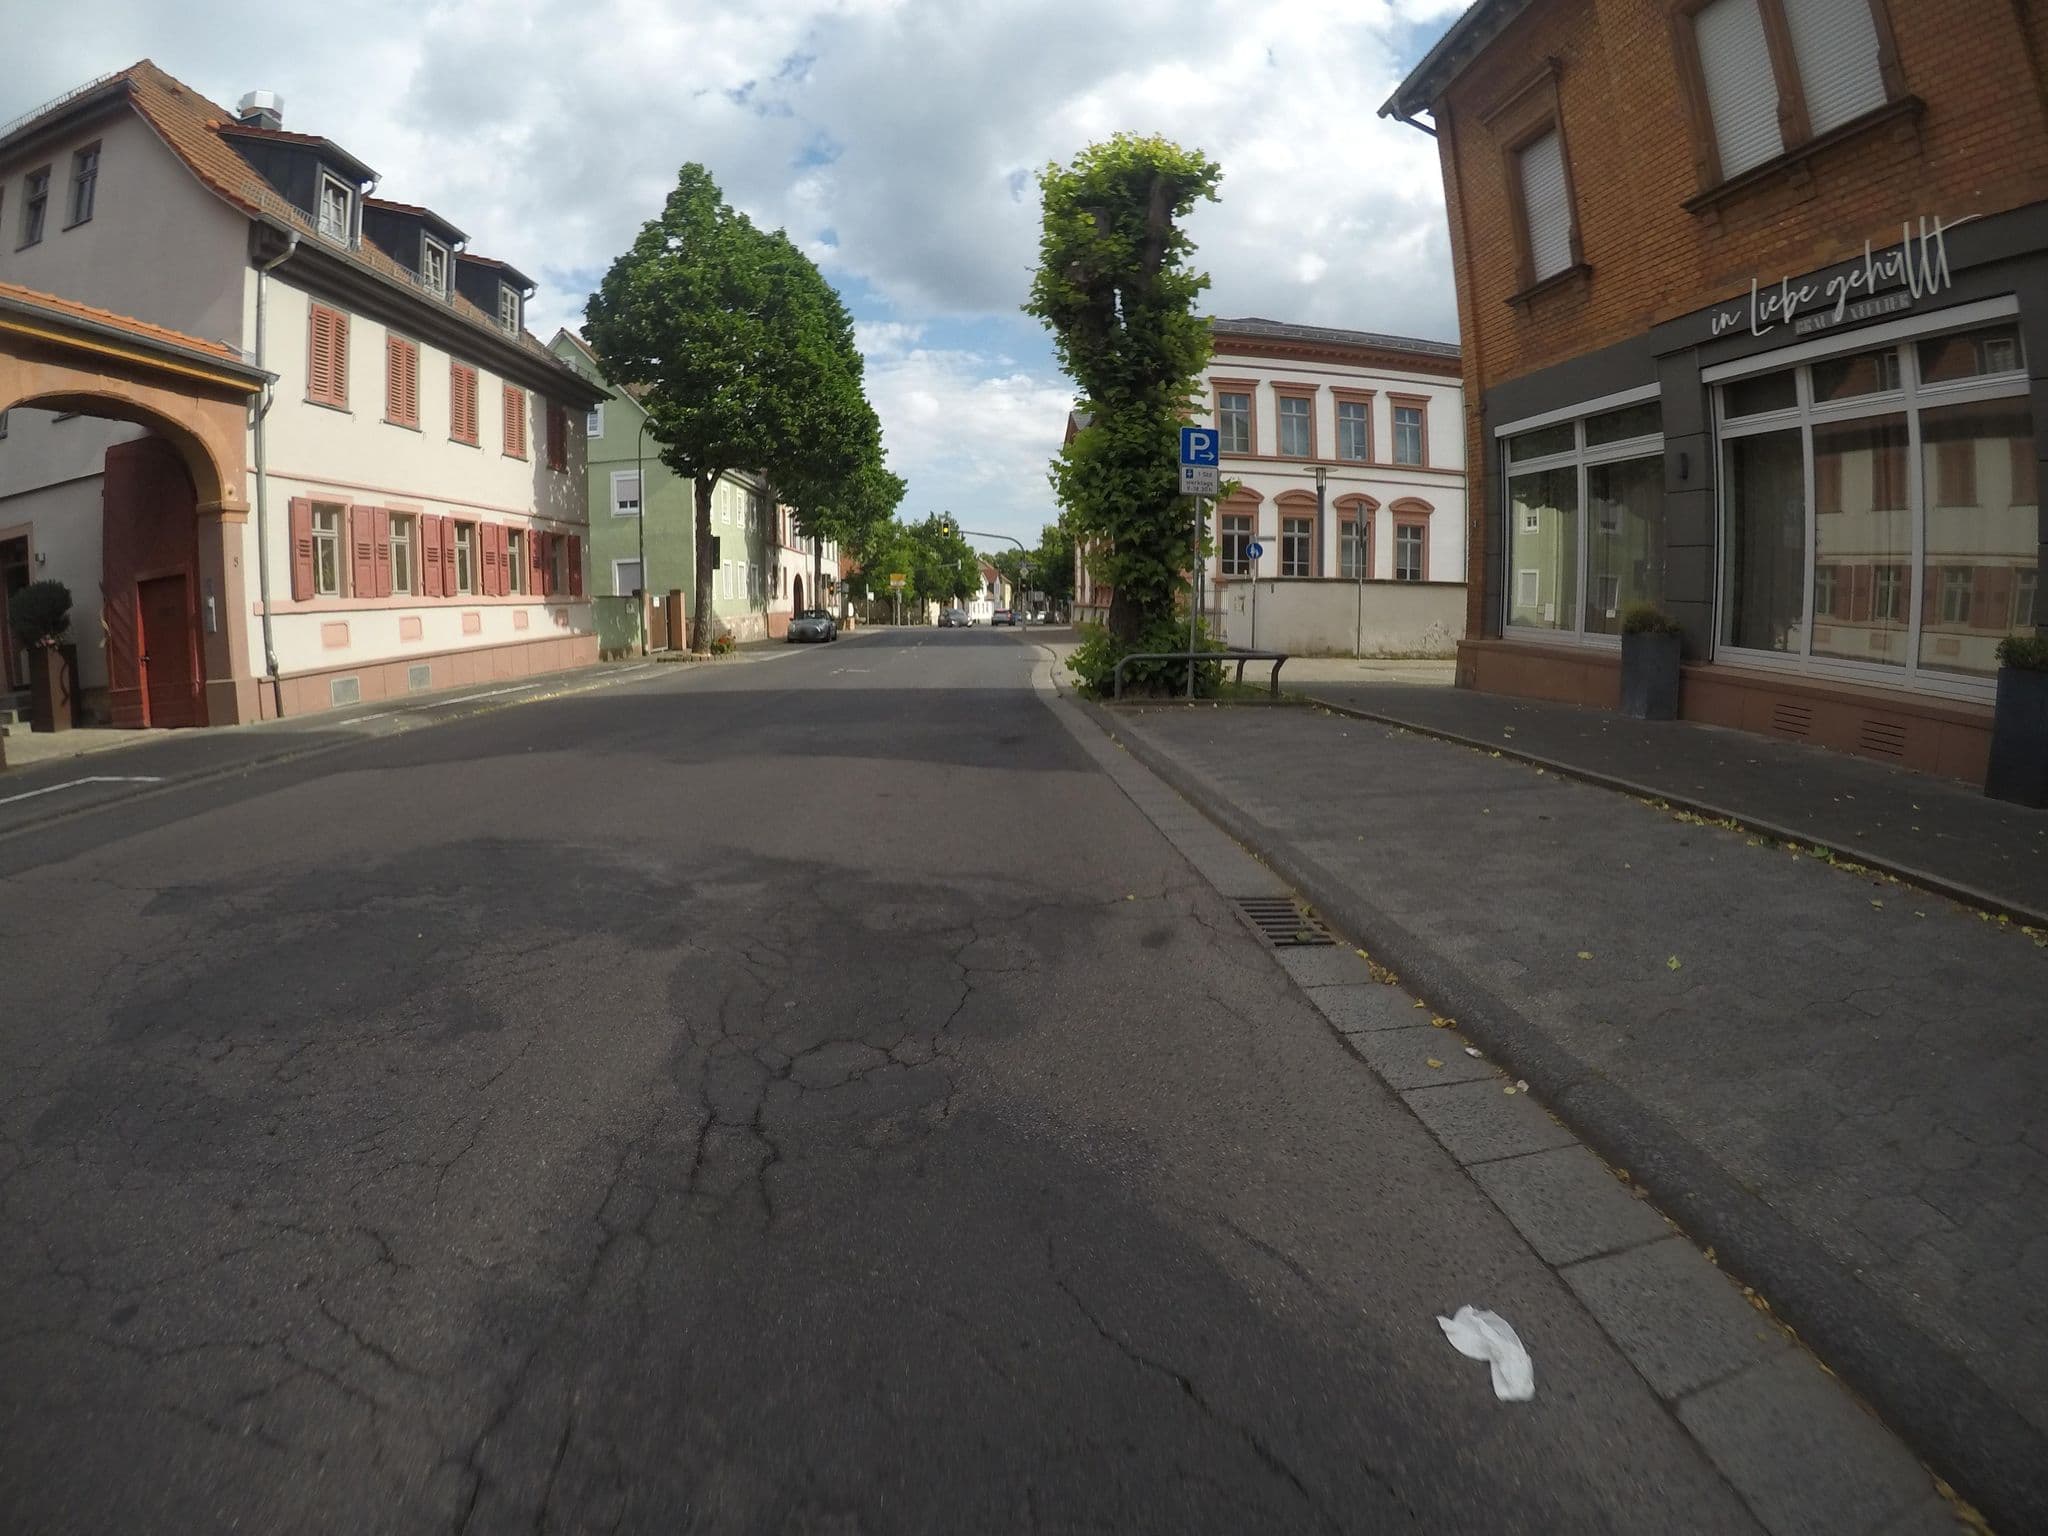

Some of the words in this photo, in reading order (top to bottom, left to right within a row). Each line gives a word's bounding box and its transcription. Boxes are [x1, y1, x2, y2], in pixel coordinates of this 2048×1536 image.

[1711, 309, 1742, 336] in
[1750, 276, 1818, 337] Liebe
[1190, 432, 1211, 460] P
